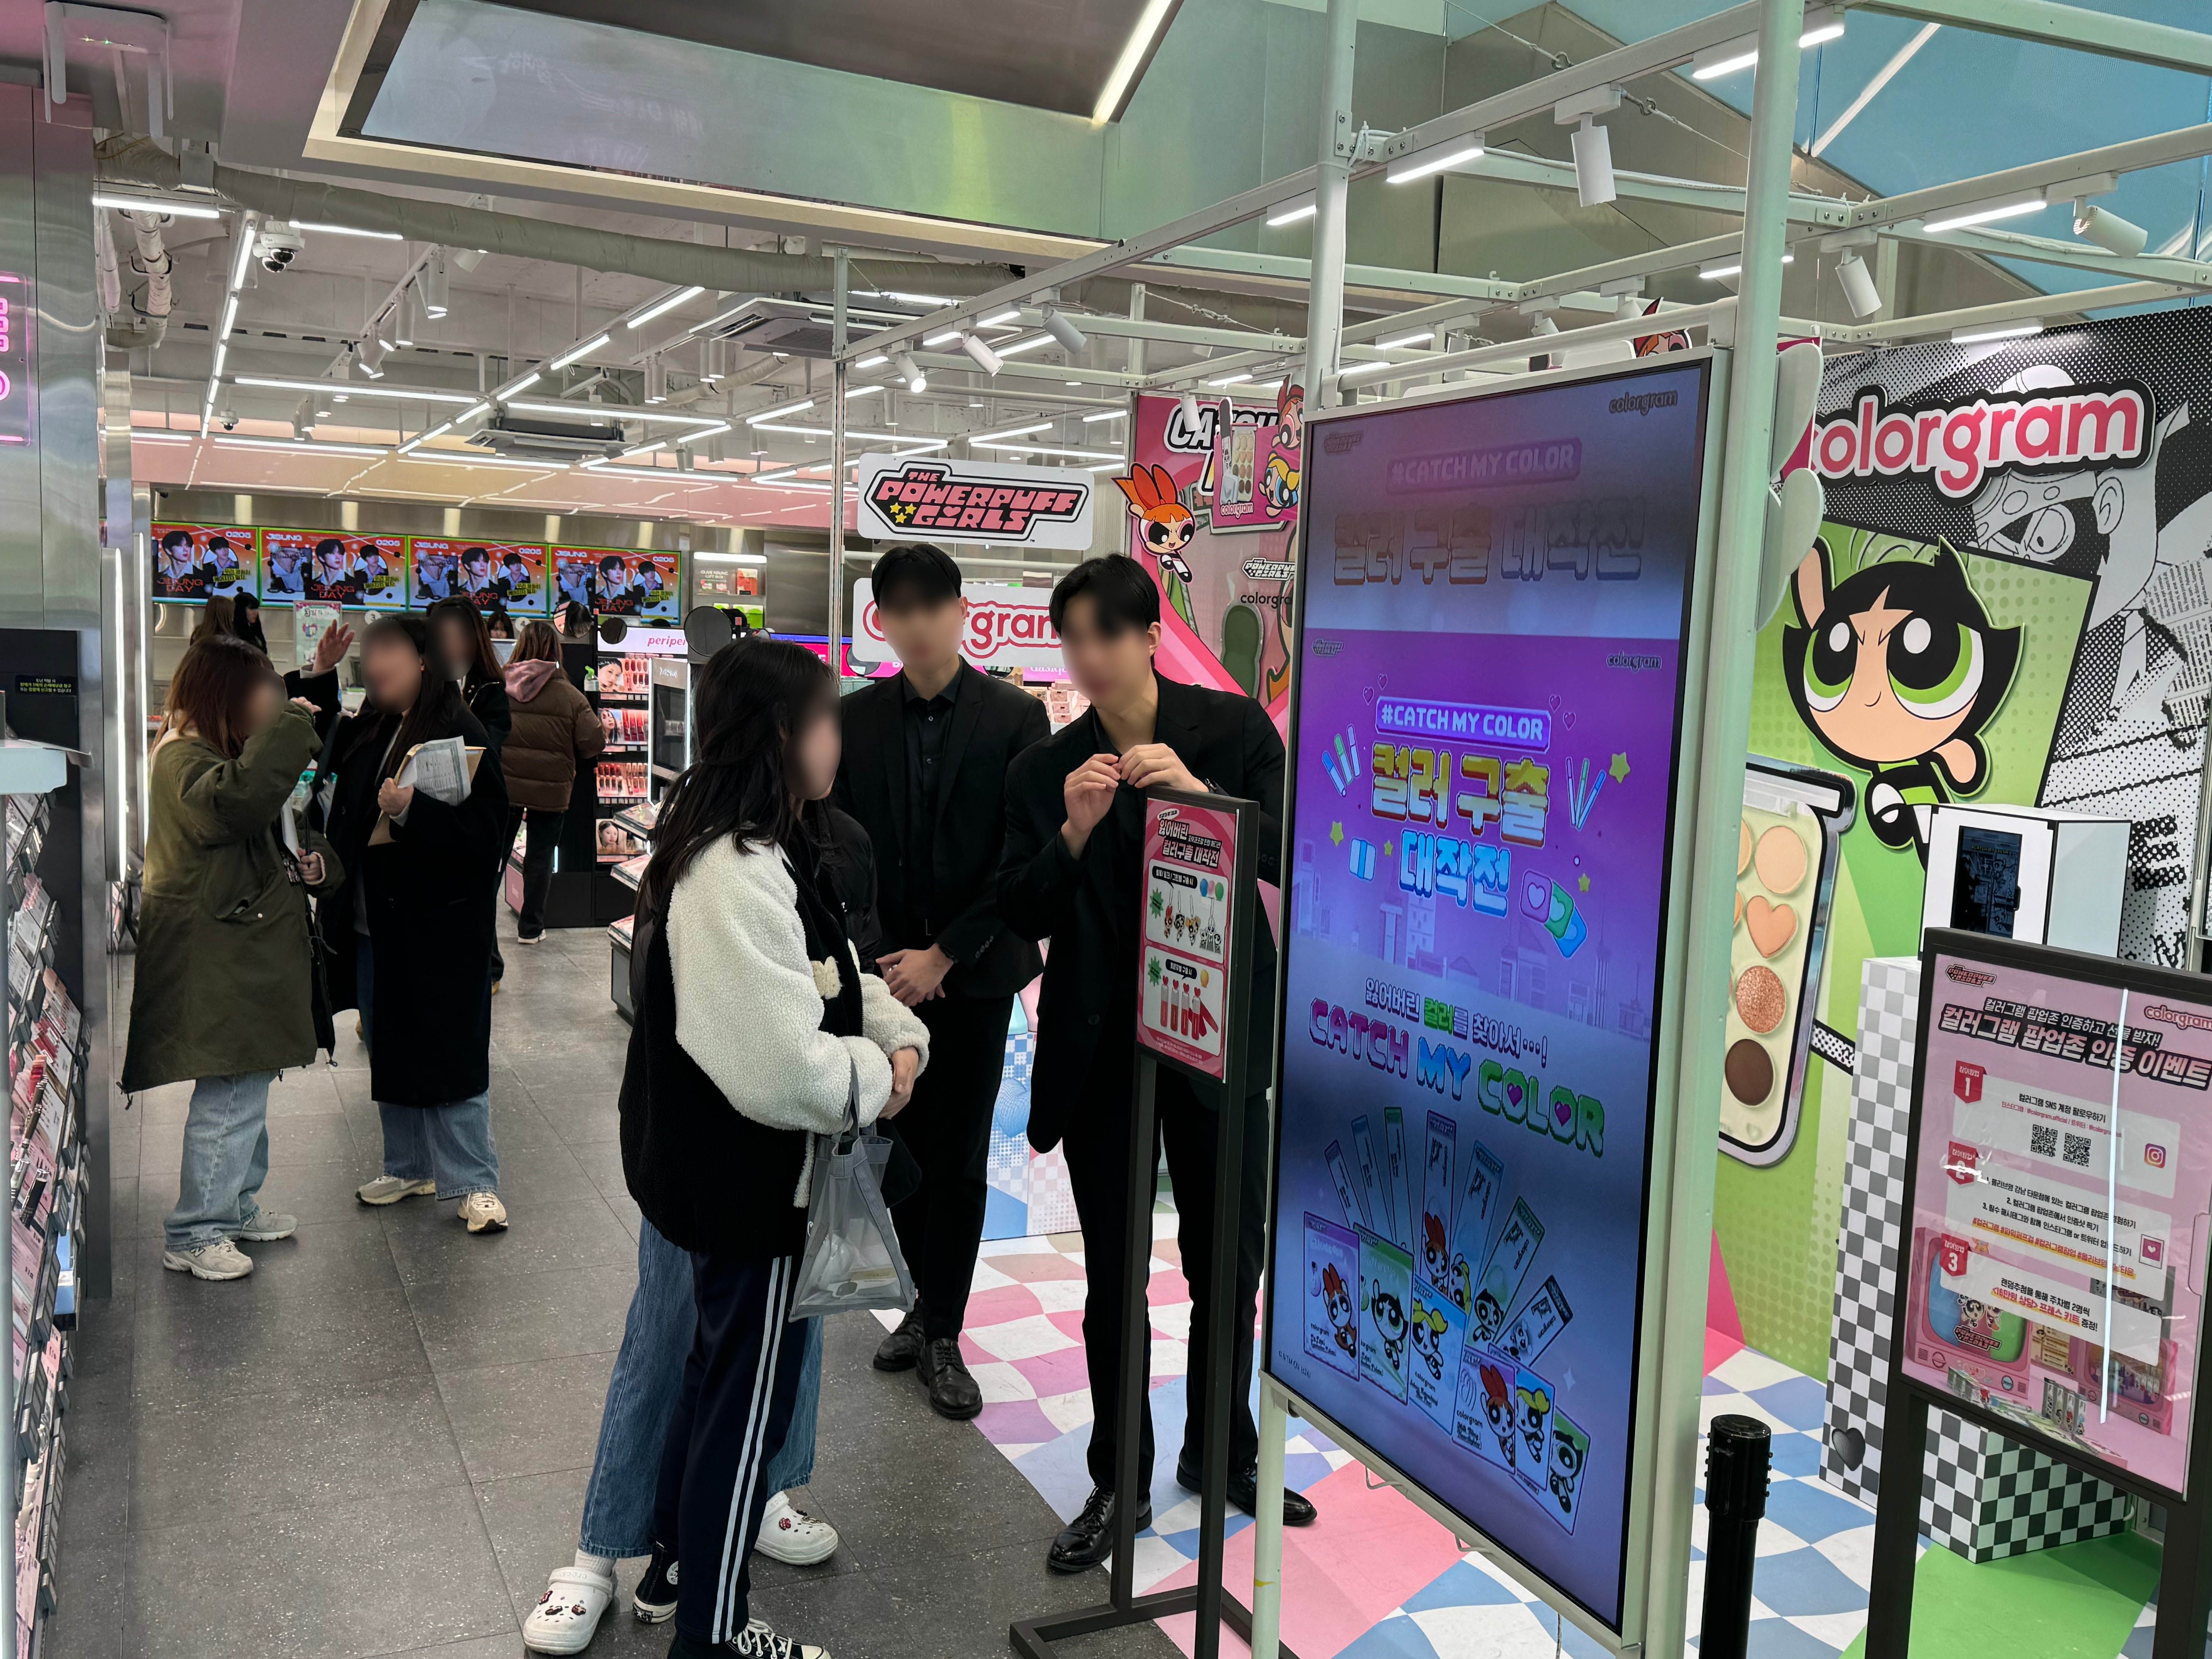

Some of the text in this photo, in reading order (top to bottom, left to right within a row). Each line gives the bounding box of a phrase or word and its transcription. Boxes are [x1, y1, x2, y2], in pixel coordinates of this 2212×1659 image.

[1609, 390, 1678, 416] colorgram
[1813, 397, 2138, 491] olorgram
[908, 471, 940, 482] THE
[1392, 444, 1575, 484] #CATCH MY COLOR
[876, 481, 1079, 512] POWERPUFF
[1221, 504, 1253, 517] colorgram
[912, 505, 1030, 531] GIRLS
[319, 591, 346, 599] DAY
[1240, 592, 1292, 609] colorgra
[1607, 652, 1662, 671] colorgram
[1381, 705, 1543, 740] #CATCH MY COLOR
[1372, 742, 1549, 848] 컬러 구출
[1194, 847, 1219, 867] 대작전
[1399, 829, 1511, 917] 대작전
[1365, 978, 1420, 1023] 잃어버린
[1424, 996, 1468, 1041] 컬러를
[1985, 998, 2026, 1018] 컬러그램
[2027, 1008, 2059, 1025] 팝업존
[2061, 1013, 2106, 1035] 인증하고
[2132, 1029, 2161, 1047] 받자!
[2146, 1006, 2212, 1029] colorgram
[1941, 1006, 2212, 1087] 컬러그램 팝업존 인증 이벤트
[1309, 998, 1410, 1079] CATCH
[1416, 1036, 1471, 1101] MY
[1477, 1059, 1605, 1158] COLOR
[1965, 1077, 1971, 1097] 1
[2019, 1093, 2106, 1123] 컬러그램 SNS 계정 팔로우하기
[1992, 1178, 2013, 1192] 올리브영
[2014, 1185, 2026, 1195] 강남
[2027, 1189, 2050, 1202] 타운점에
[2051, 1196, 2064, 1207] 있는
[2066, 1201, 2090, 1215] 컬러그램
[2013, 1199, 2035, 1212] 컬러그램
[2037, 1206, 2066, 1222] 팝업존에서
[1972, 1217, 2000, 1232] #컬러그램
[1989, 1204, 2000, 1214] 필수
[2001, 1208, 2029, 1223] 해시태그와
[2030, 1217, 2041, 1228] 함께
[2043, 1222, 2072, 1237] 인스타그램
[2080, 1234, 2099, 1246] 트위터
[2100, 1240, 2131, 1256] 업드하기
[1948, 1252, 1958, 1272] 3
[2001, 1278, 2090, 1317] 랜덤추첨을 통해 주차별 2명씩
[2040, 1302, 2062, 1319] 프레스
[2064, 1311, 2080, 1325] 키트
[2081, 1318, 2098, 1332] 증정!
